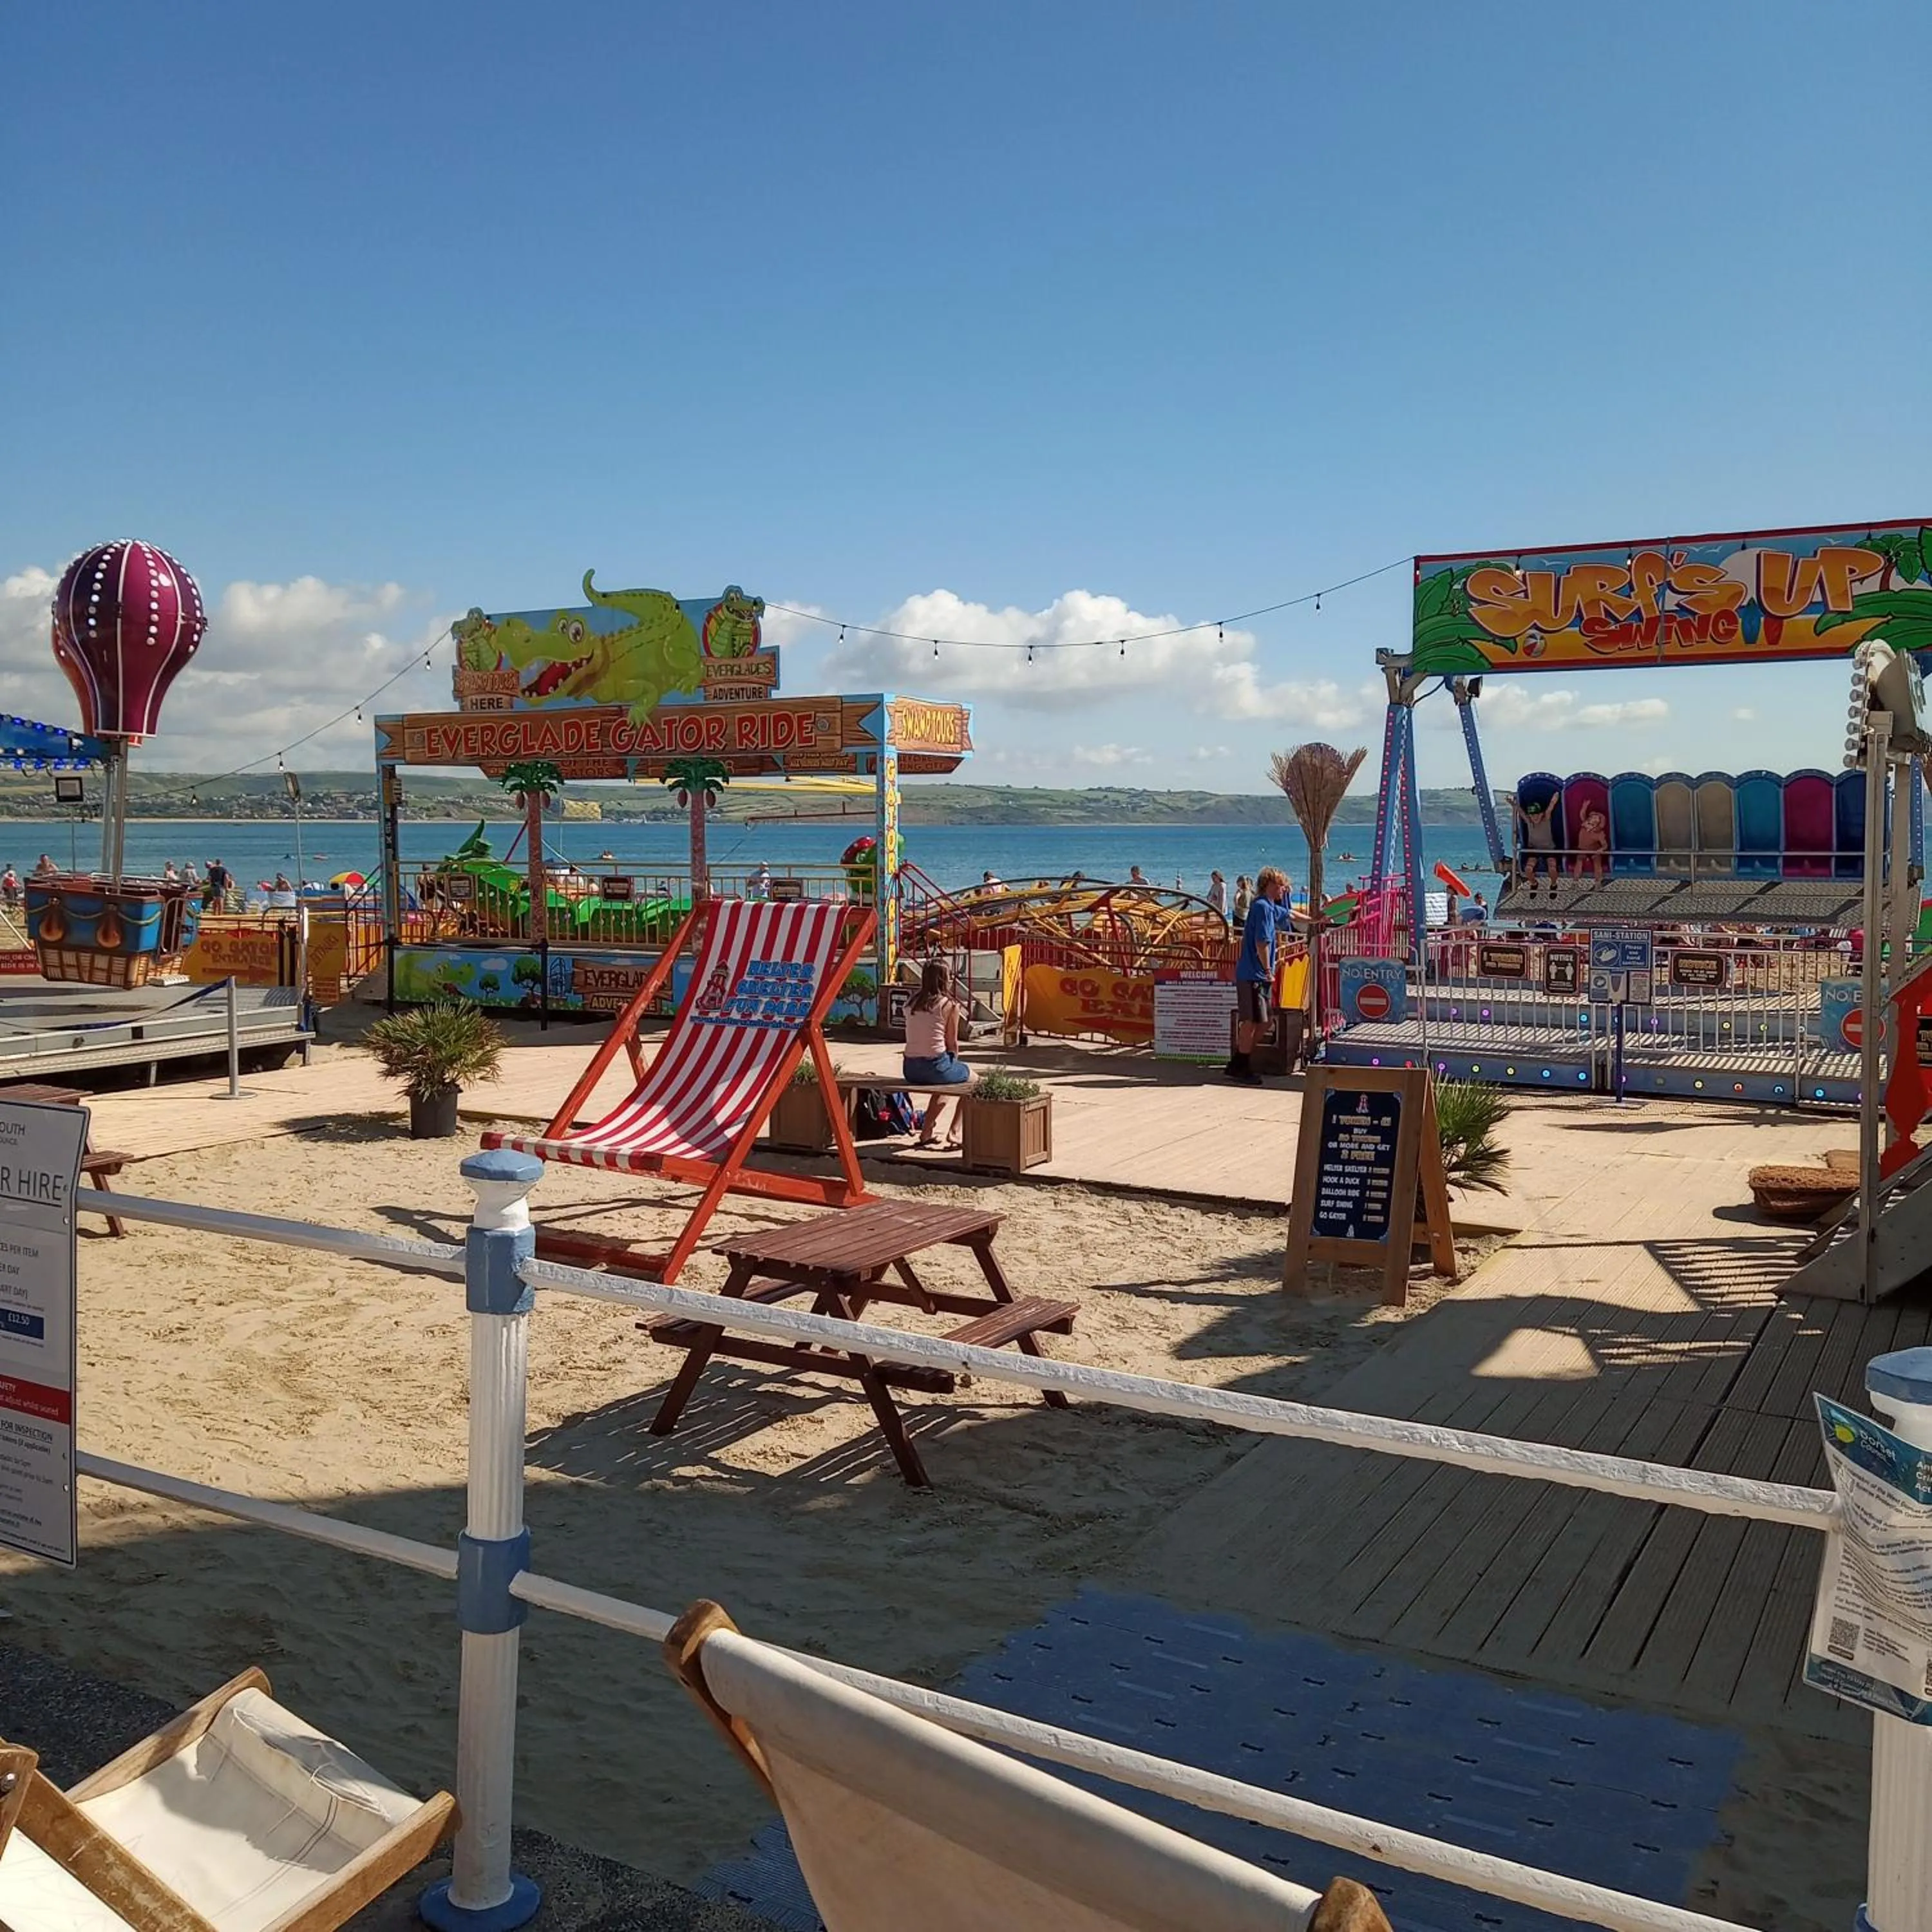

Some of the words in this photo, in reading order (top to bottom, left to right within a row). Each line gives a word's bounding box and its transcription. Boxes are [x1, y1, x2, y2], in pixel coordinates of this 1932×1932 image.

[1757, 547, 1886, 617] UP
[1582, 609, 1741, 653] SWING
[708, 662, 772, 678] EVERGLADES
[713, 687, 763, 701] ADVENTURE
[470, 697, 504, 710] HERE
[902, 706, 931, 743] SWAMP
[931, 709, 955, 745] TOURS
[426, 719, 602, 758] EVERGLADE
[609, 714, 728, 752] GATOR
[735, 710, 815, 750] RIDE
[1593, 931, 1649, 940] SANI-STATION
[200, 940, 222, 953] GO
[748, 960, 815, 978] HELTER
[1179, 971, 1218, 979] WELCOME
[1341, 966, 1361, 979] NO
[1364, 968, 1402, 980] ENTRY
[583, 969, 668, 989] EVERGLAD
[737, 980, 815, 999] SKELTER
[1059, 977, 1100, 997] GO
[1826, 989, 1848, 1002] NO
[723, 997, 762, 1013] FUN
[762, 1000, 813, 1018] PARK
[1344, 1165, 1367, 1173] SKELTER
[18, 1169, 64, 1201] HIRE
[1322, 1175, 1339, 1184] HOOK
[1321, 1188, 1347, 1196] BALLOON
[1347, 1189, 1361, 1197] RIDE
[1320, 1199, 1335, 1208] SURF
[1329, 1211, 1347, 1220] GATOR
[1, 1419, 14, 1431] FOR
[14, 1423, 53, 1441] INSPECTION
[1860, 1429, 1897, 1461] Dorset
[1915, 1482, 1932, 1494] Act
